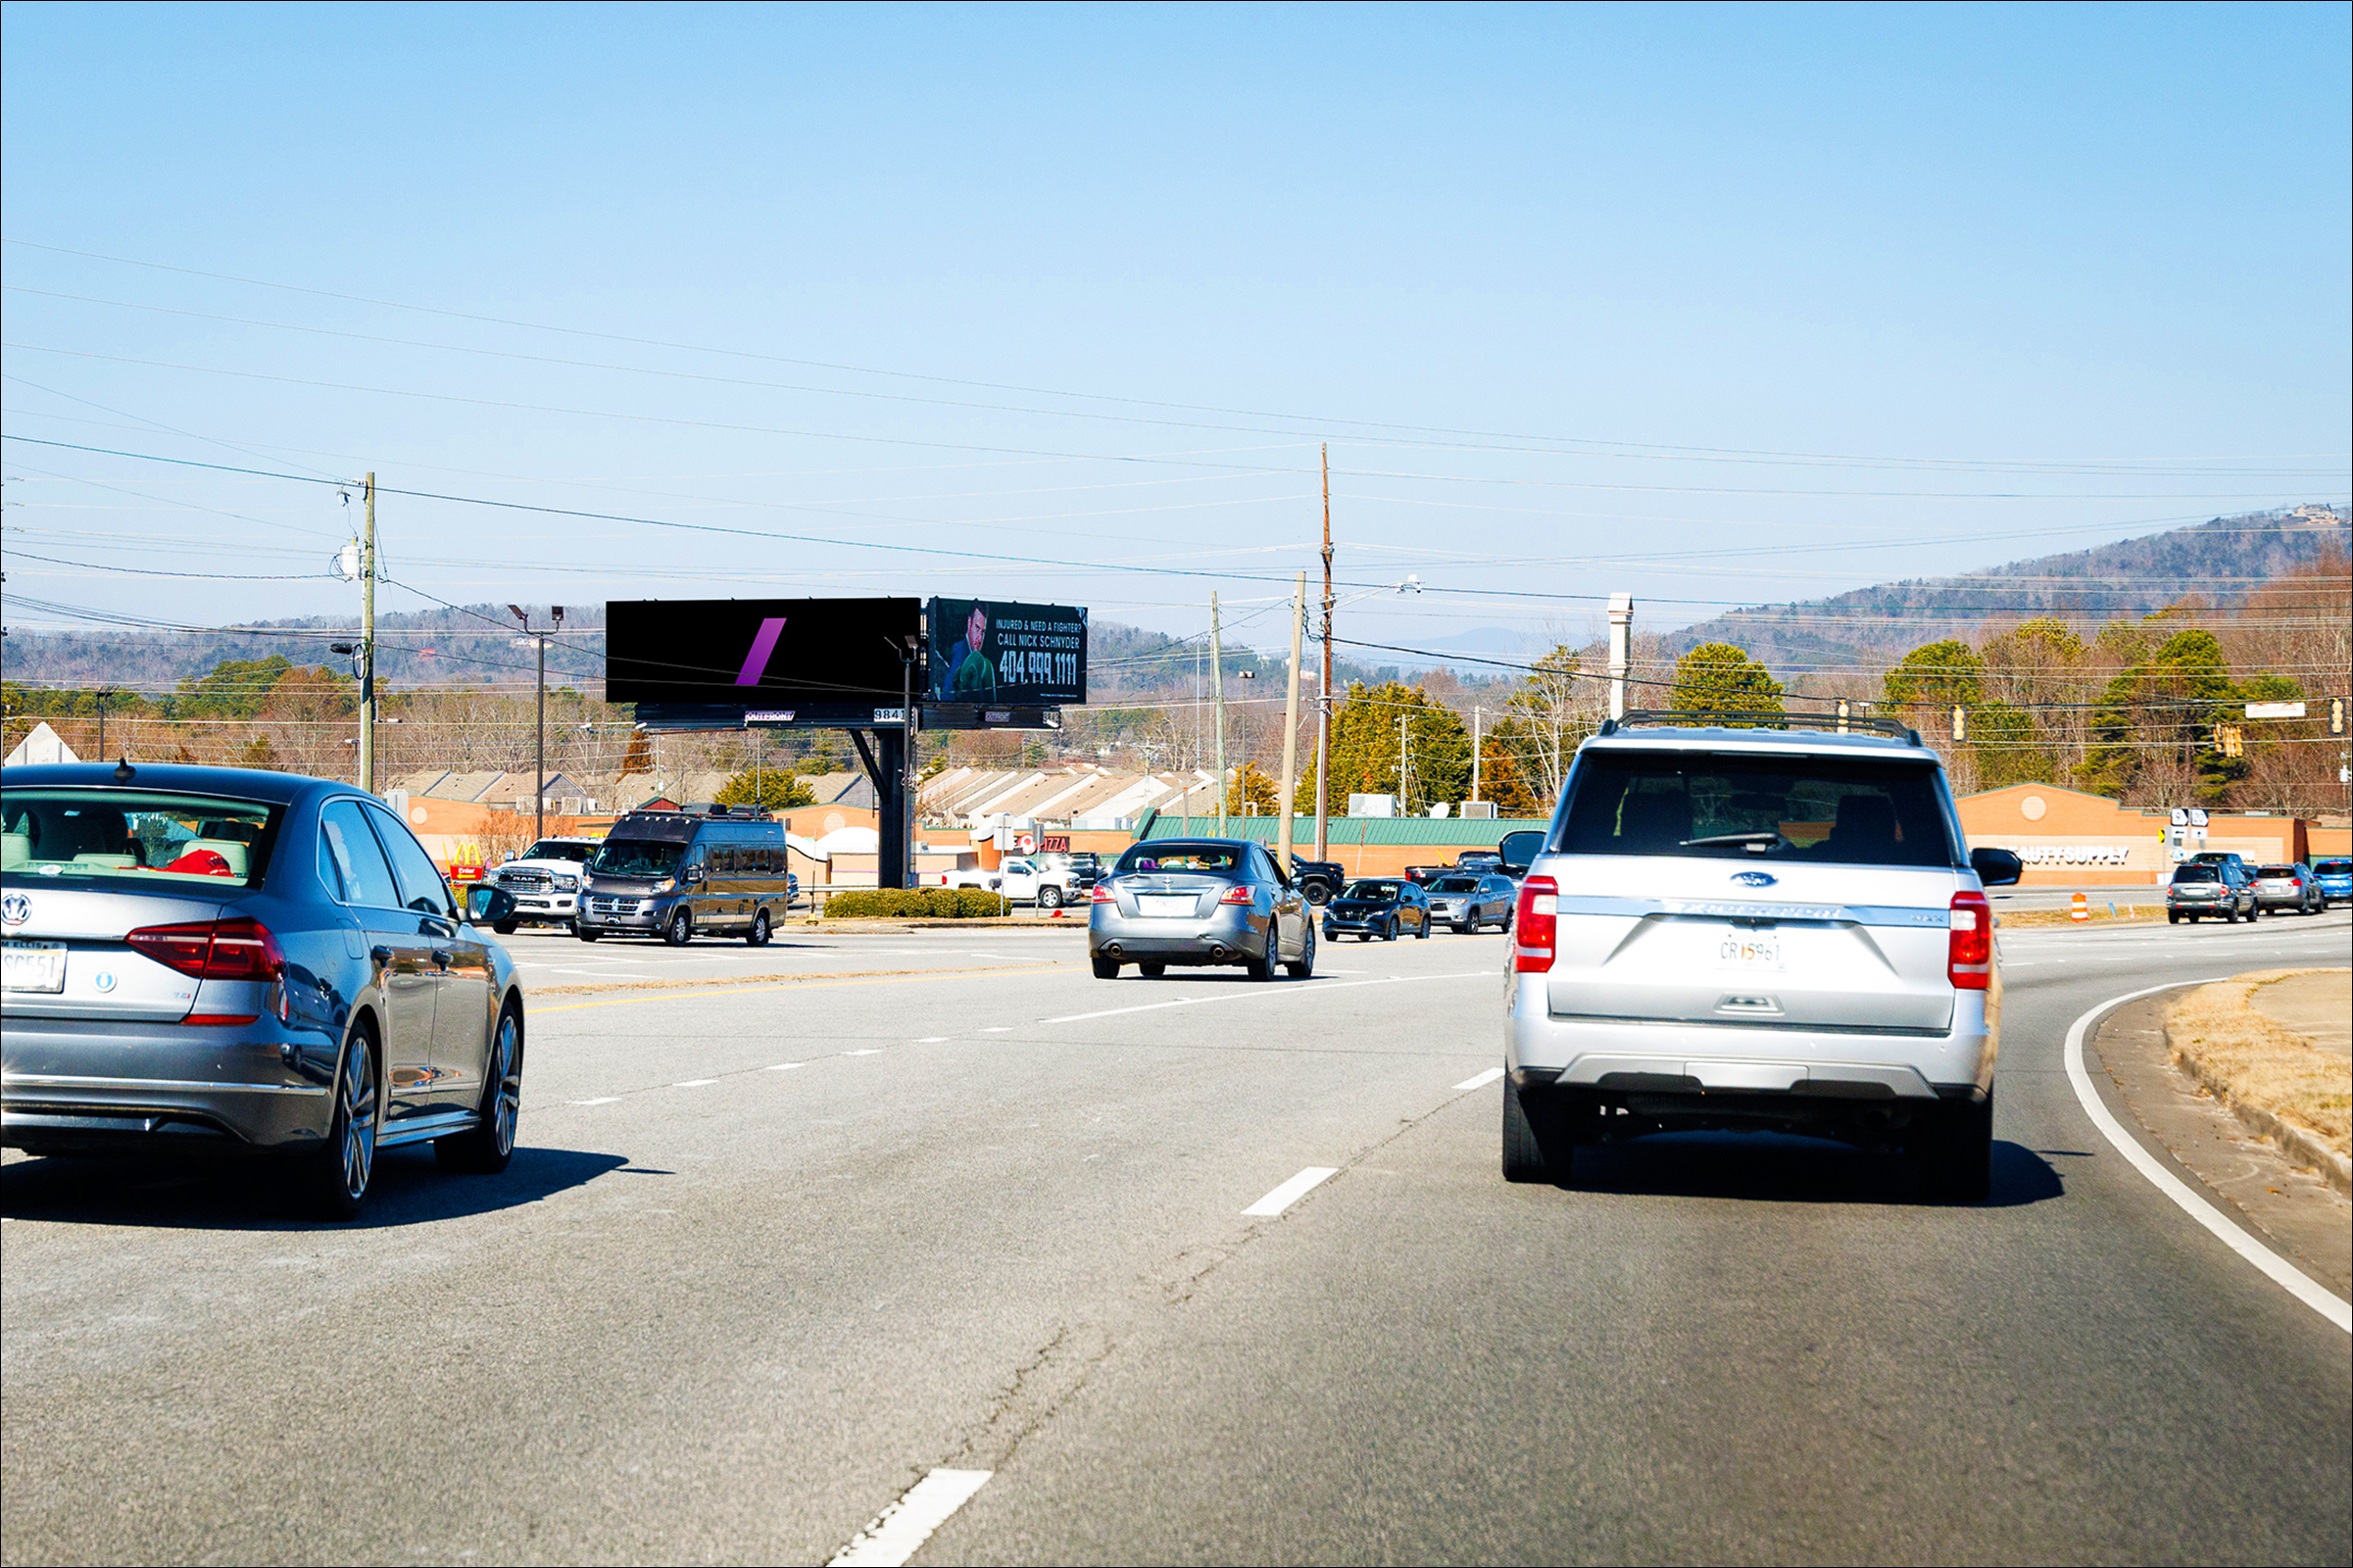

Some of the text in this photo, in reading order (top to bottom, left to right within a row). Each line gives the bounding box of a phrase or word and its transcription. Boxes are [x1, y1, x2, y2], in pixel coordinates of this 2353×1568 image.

[996, 618, 1082, 634] INJURED & NEED A FIGHTER?
[997, 632, 1080, 649] CALL NICK SCHNYDER
[1000, 650, 1077, 685] 404.999.1111
[874, 710, 905, 720] 9841
[2063, 846, 2130, 865] SUPPLY
